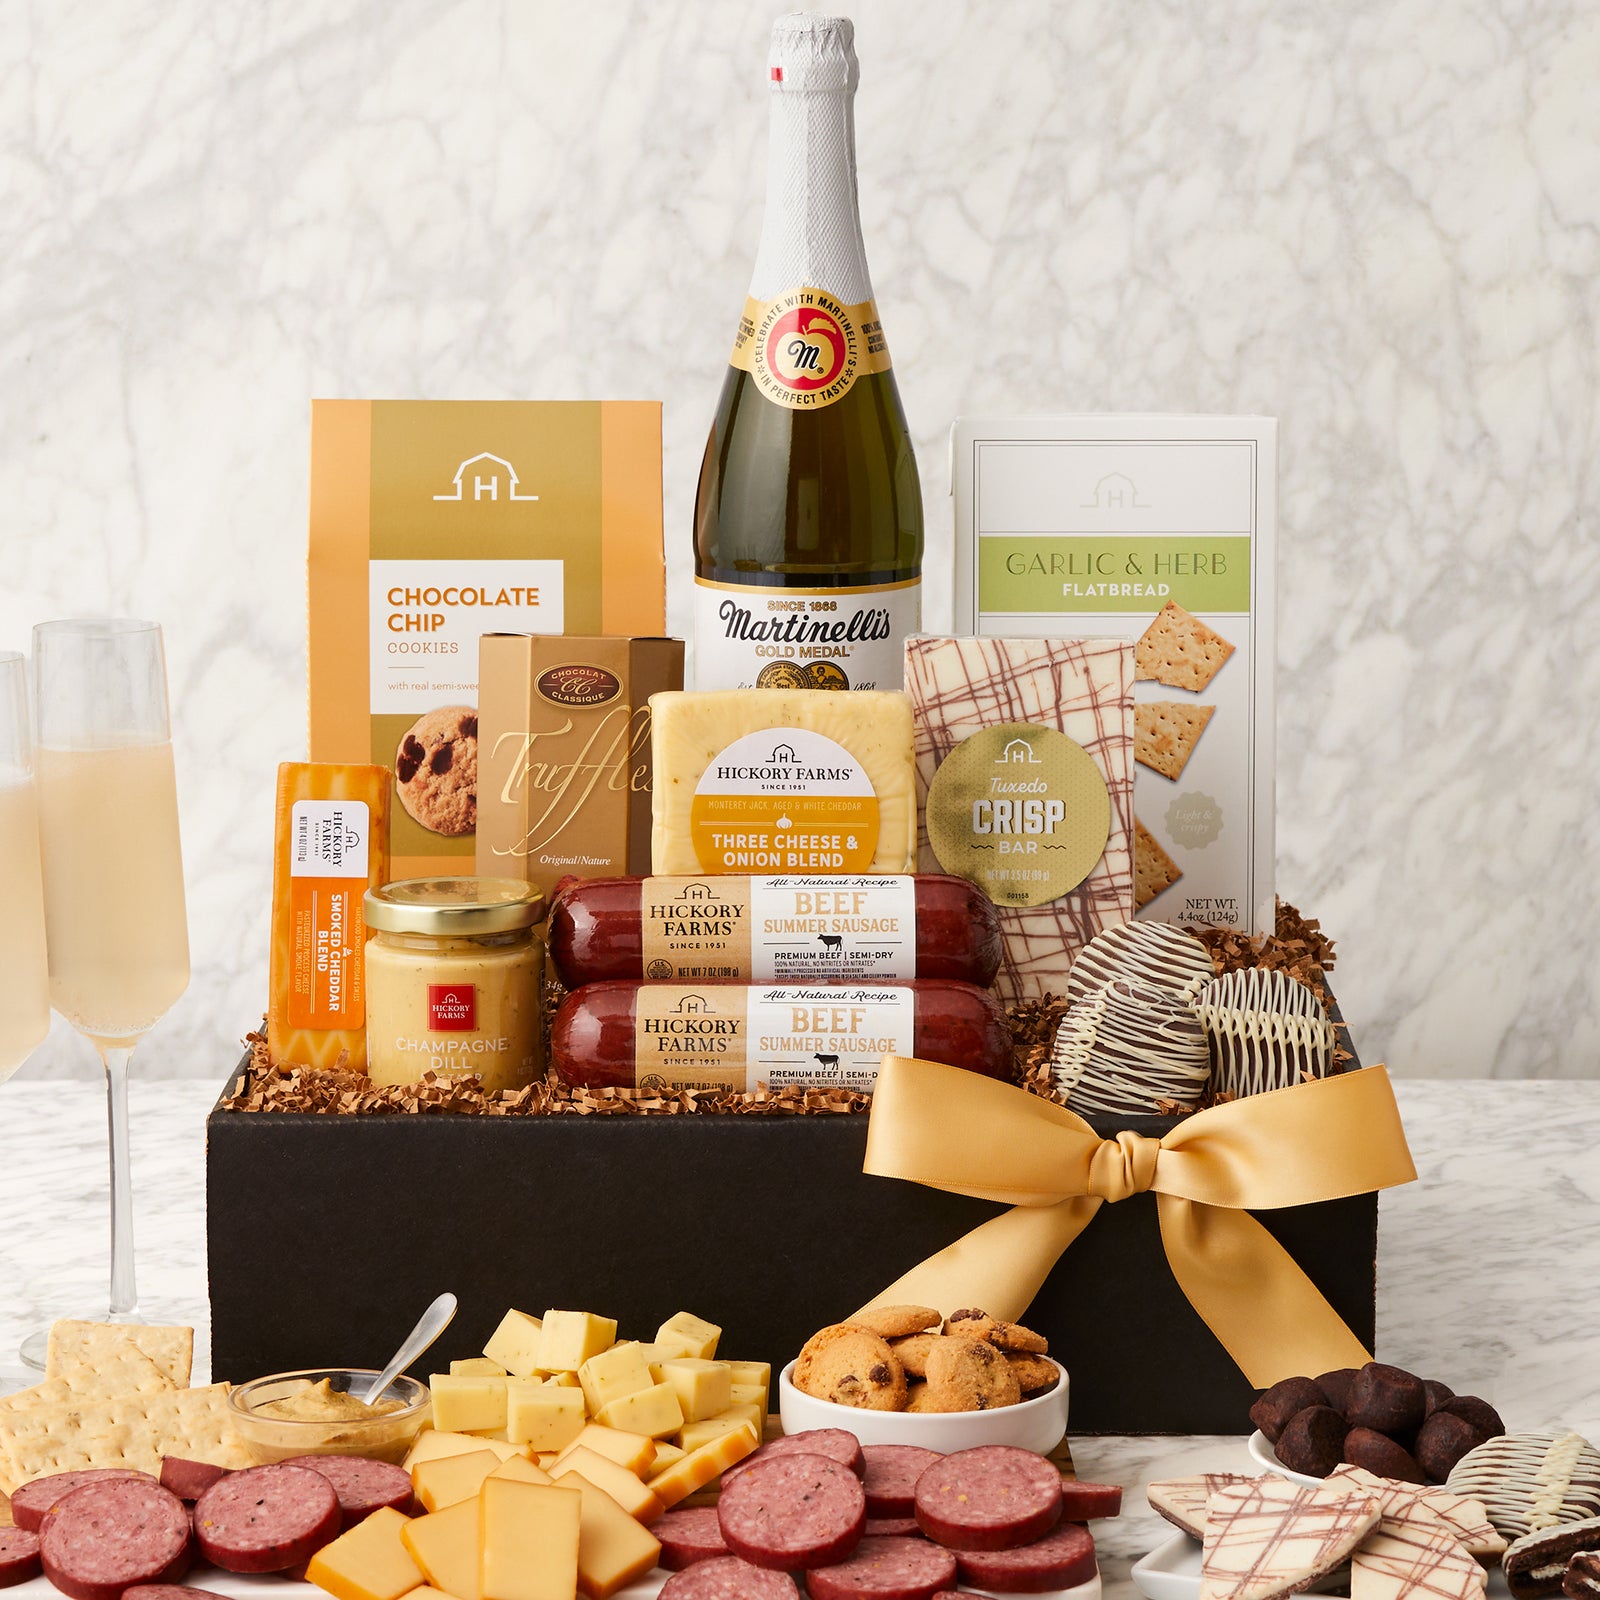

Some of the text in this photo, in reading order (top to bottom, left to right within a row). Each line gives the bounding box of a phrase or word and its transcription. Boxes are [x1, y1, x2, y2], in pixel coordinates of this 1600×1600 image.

[755, 305, 783, 363] CELEBRATE
[784, 294, 813, 308] WITH
[817, 296, 857, 367] MARTINELLI'S
[760, 374, 850, 404] IN PERFECT TASTE
[1006, 553, 1227, 575] GARLIC & HERB
[387, 587, 540, 606] CHOCOLATE
[1063, 583, 1170, 596] FLATBREAD
[767, 600, 837, 611] SINCE 1868
[387, 613, 445, 632] CHIP
[719, 599, 890, 643] Martinelli's
[388, 642, 459, 654] COOKIES
[755, 644, 795, 658] GOLD
[551, 669, 607, 680] CHOCOLAT
[388, 681, 480, 691] with real semi-swee
[551, 691, 605, 703] CLASSIQUE
[717, 767, 851, 780] HICKORY FARMS
[990, 777, 1048, 793] Tuxedo
[708, 801, 747, 809] MONTEREY
[773, 802, 792, 810] AGED
[803, 802, 825, 810] WHITE
[828, 802, 862, 810] CHEDDAR
[973, 799, 1066, 834] CRISP
[322, 820, 331, 860] FARMS
[332, 812, 342, 867] HICKORY
[711, 833, 858, 850] THREE CHEESE &
[999, 841, 1038, 854] BAR
[539, 854, 611, 866] Original/Nature
[723, 852, 843, 867] ONION BLEND
[851, 878, 898, 887] Recipe
[795, 891, 868, 915] BEEF
[1185, 898, 1238, 909] NET WT.
[650, 905, 744, 918] HICKORY
[1177, 911, 1238, 923] 4.4oz (124g)
[664, 921, 733, 936] FARMS
[764, 918, 899, 933] SUMMER SAUSAGE
[317, 930, 327, 971] BLEND
[329, 894, 341, 1011] SMOKED CHEDDAR
[774, 952, 816, 960] PREMIUM
[678, 967, 690, 976] NET
[691, 967, 701, 976] WT
[703, 967, 707, 976] 7
[708, 967, 716, 976] OZ
[294, 972, 302, 992] FLAVOR
[850, 990, 898, 1002] Recipe
[644, 1019, 740, 1034] HICKORY
[791, 1007, 866, 1034] BEEF
[395, 1037, 508, 1054] CHAMPAGNE
[658, 1037, 728, 1052] FARMS
[759, 1037, 896, 1053] SUMMER SAUSAGE
[430, 1056, 473, 1069] DILL
